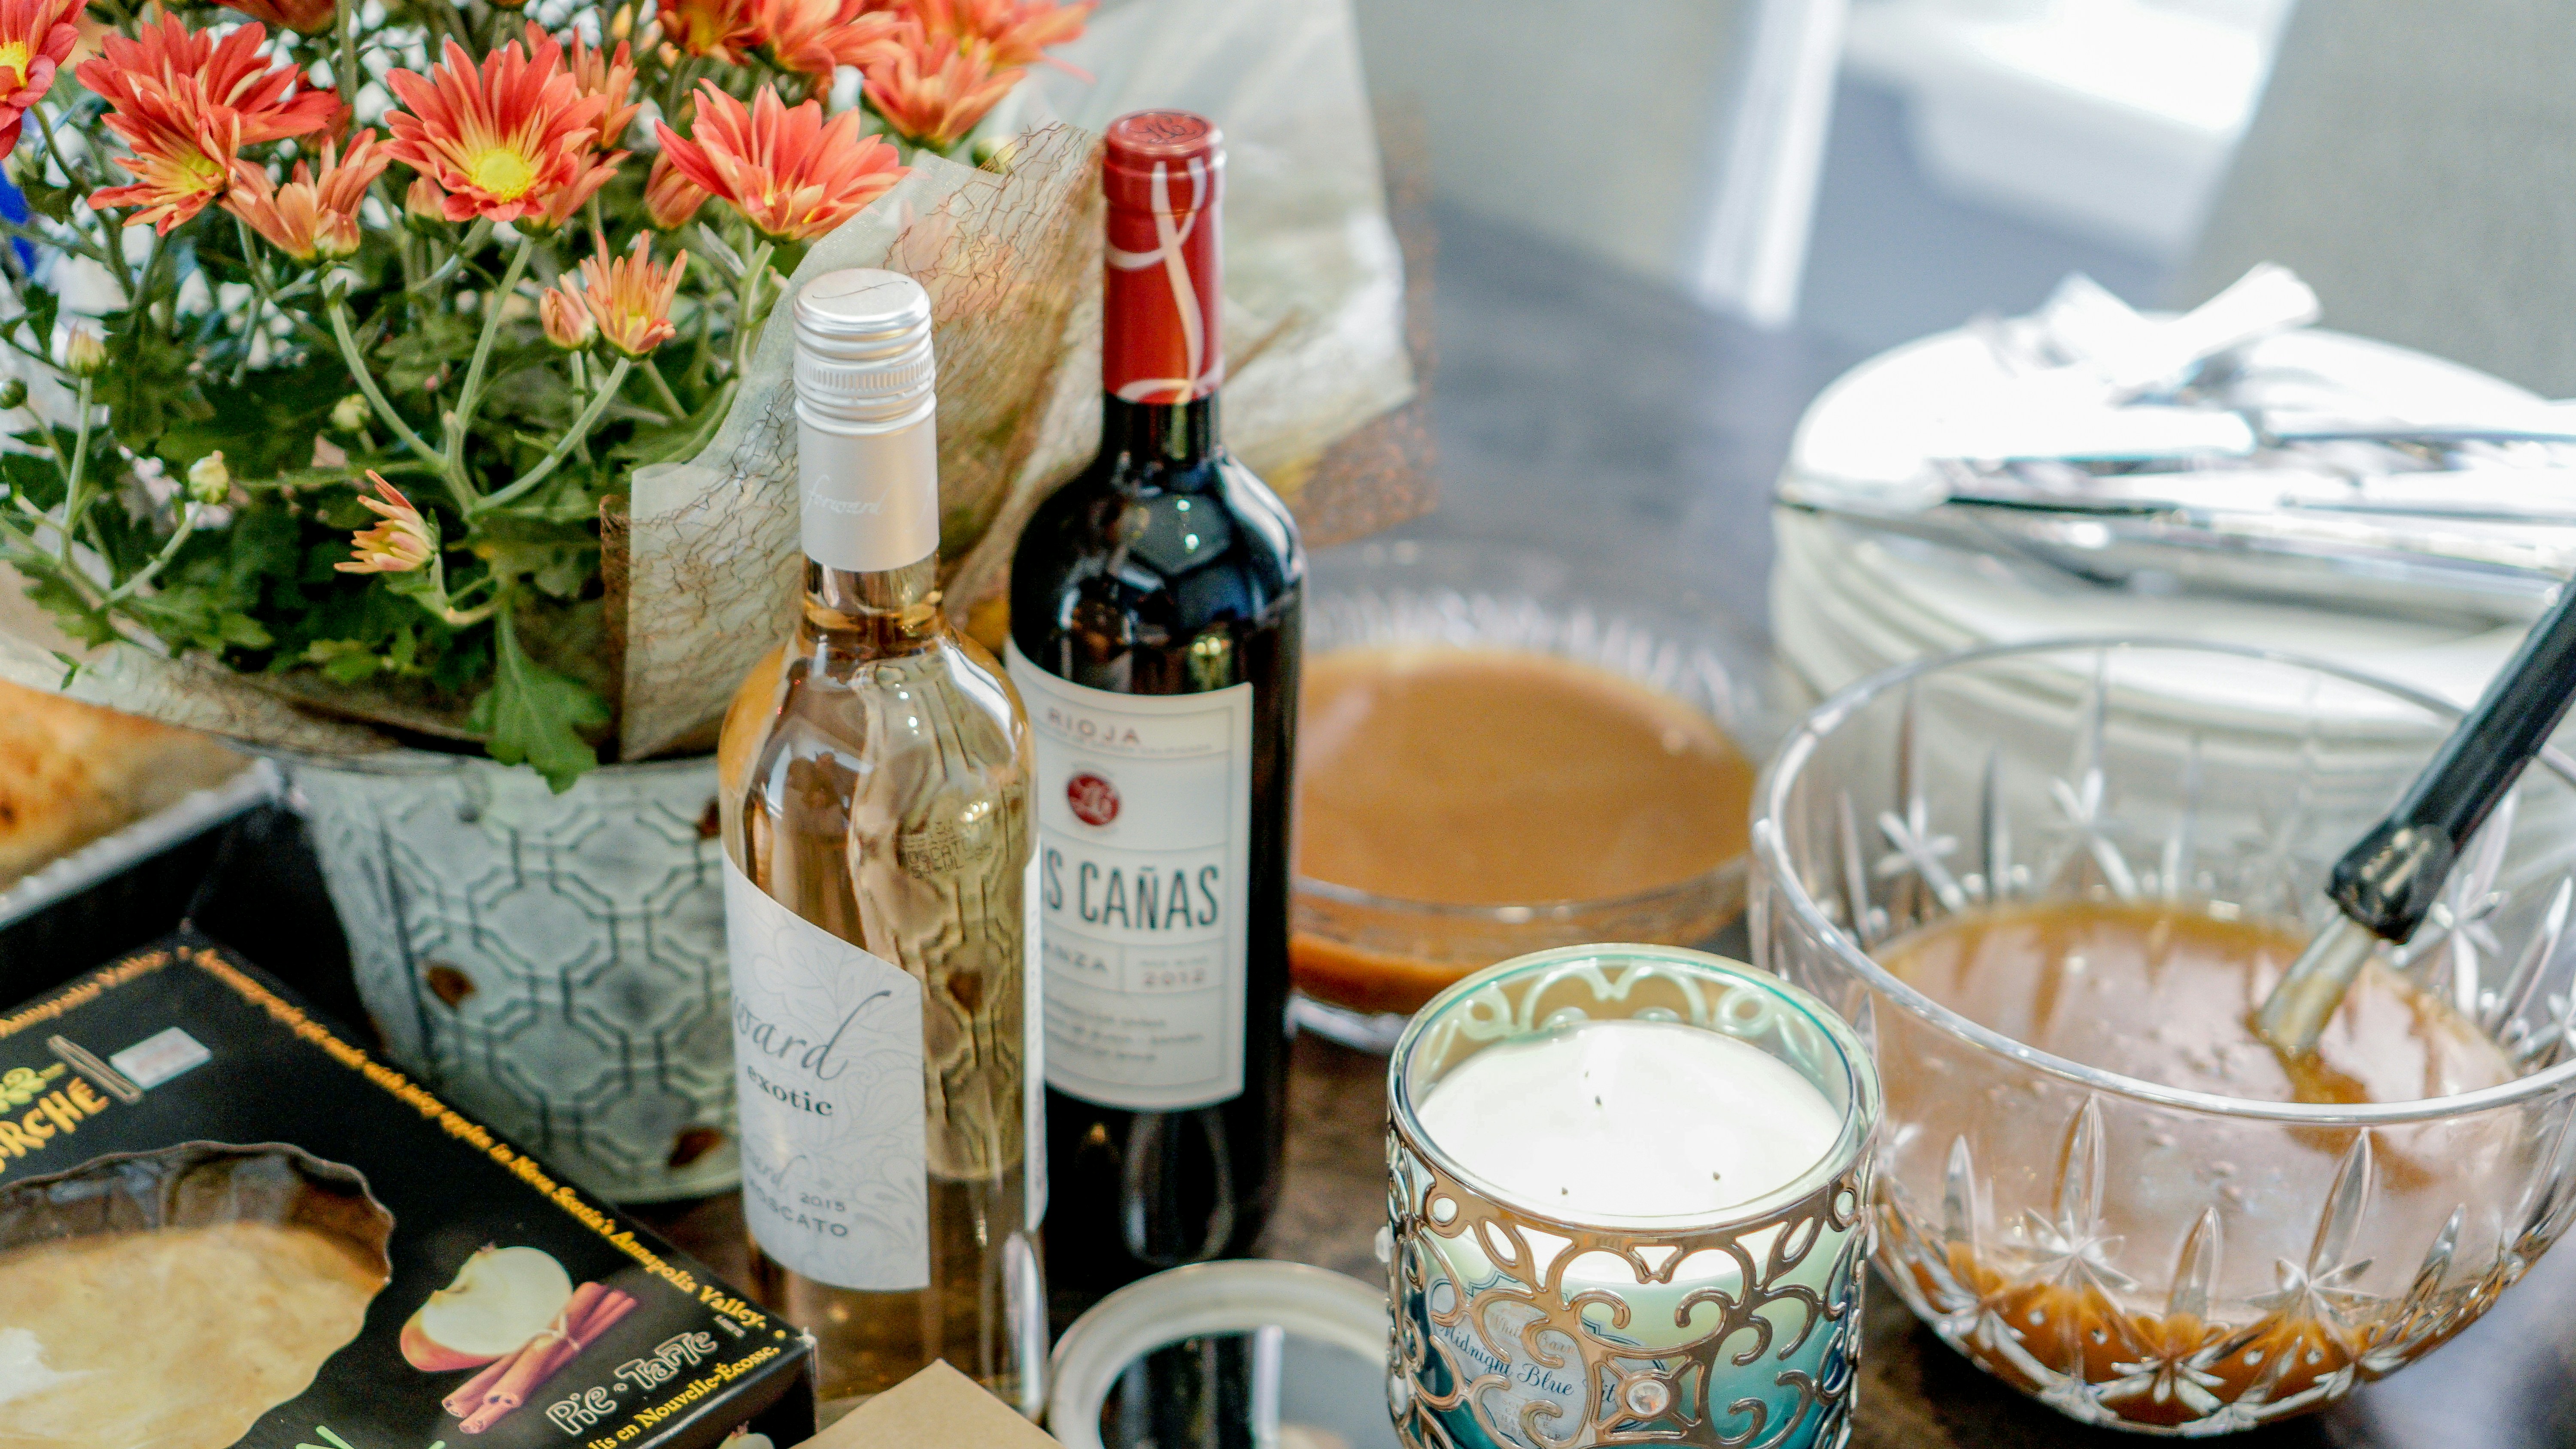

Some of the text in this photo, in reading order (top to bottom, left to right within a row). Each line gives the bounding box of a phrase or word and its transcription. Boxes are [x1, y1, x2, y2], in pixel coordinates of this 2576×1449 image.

[1048, 706, 1141, 746] RIOJA
[1079, 859, 1218, 930] CAÑAS
[747, 1065, 833, 1116] exotic
[509, 1155, 557, 1195] Nova
[609, 1231, 697, 1293] Annapolis
[1517, 1362, 1574, 1396] Blue
[545, 1385, 618, 1437] Pie
[616, 1423, 641, 1442] en
